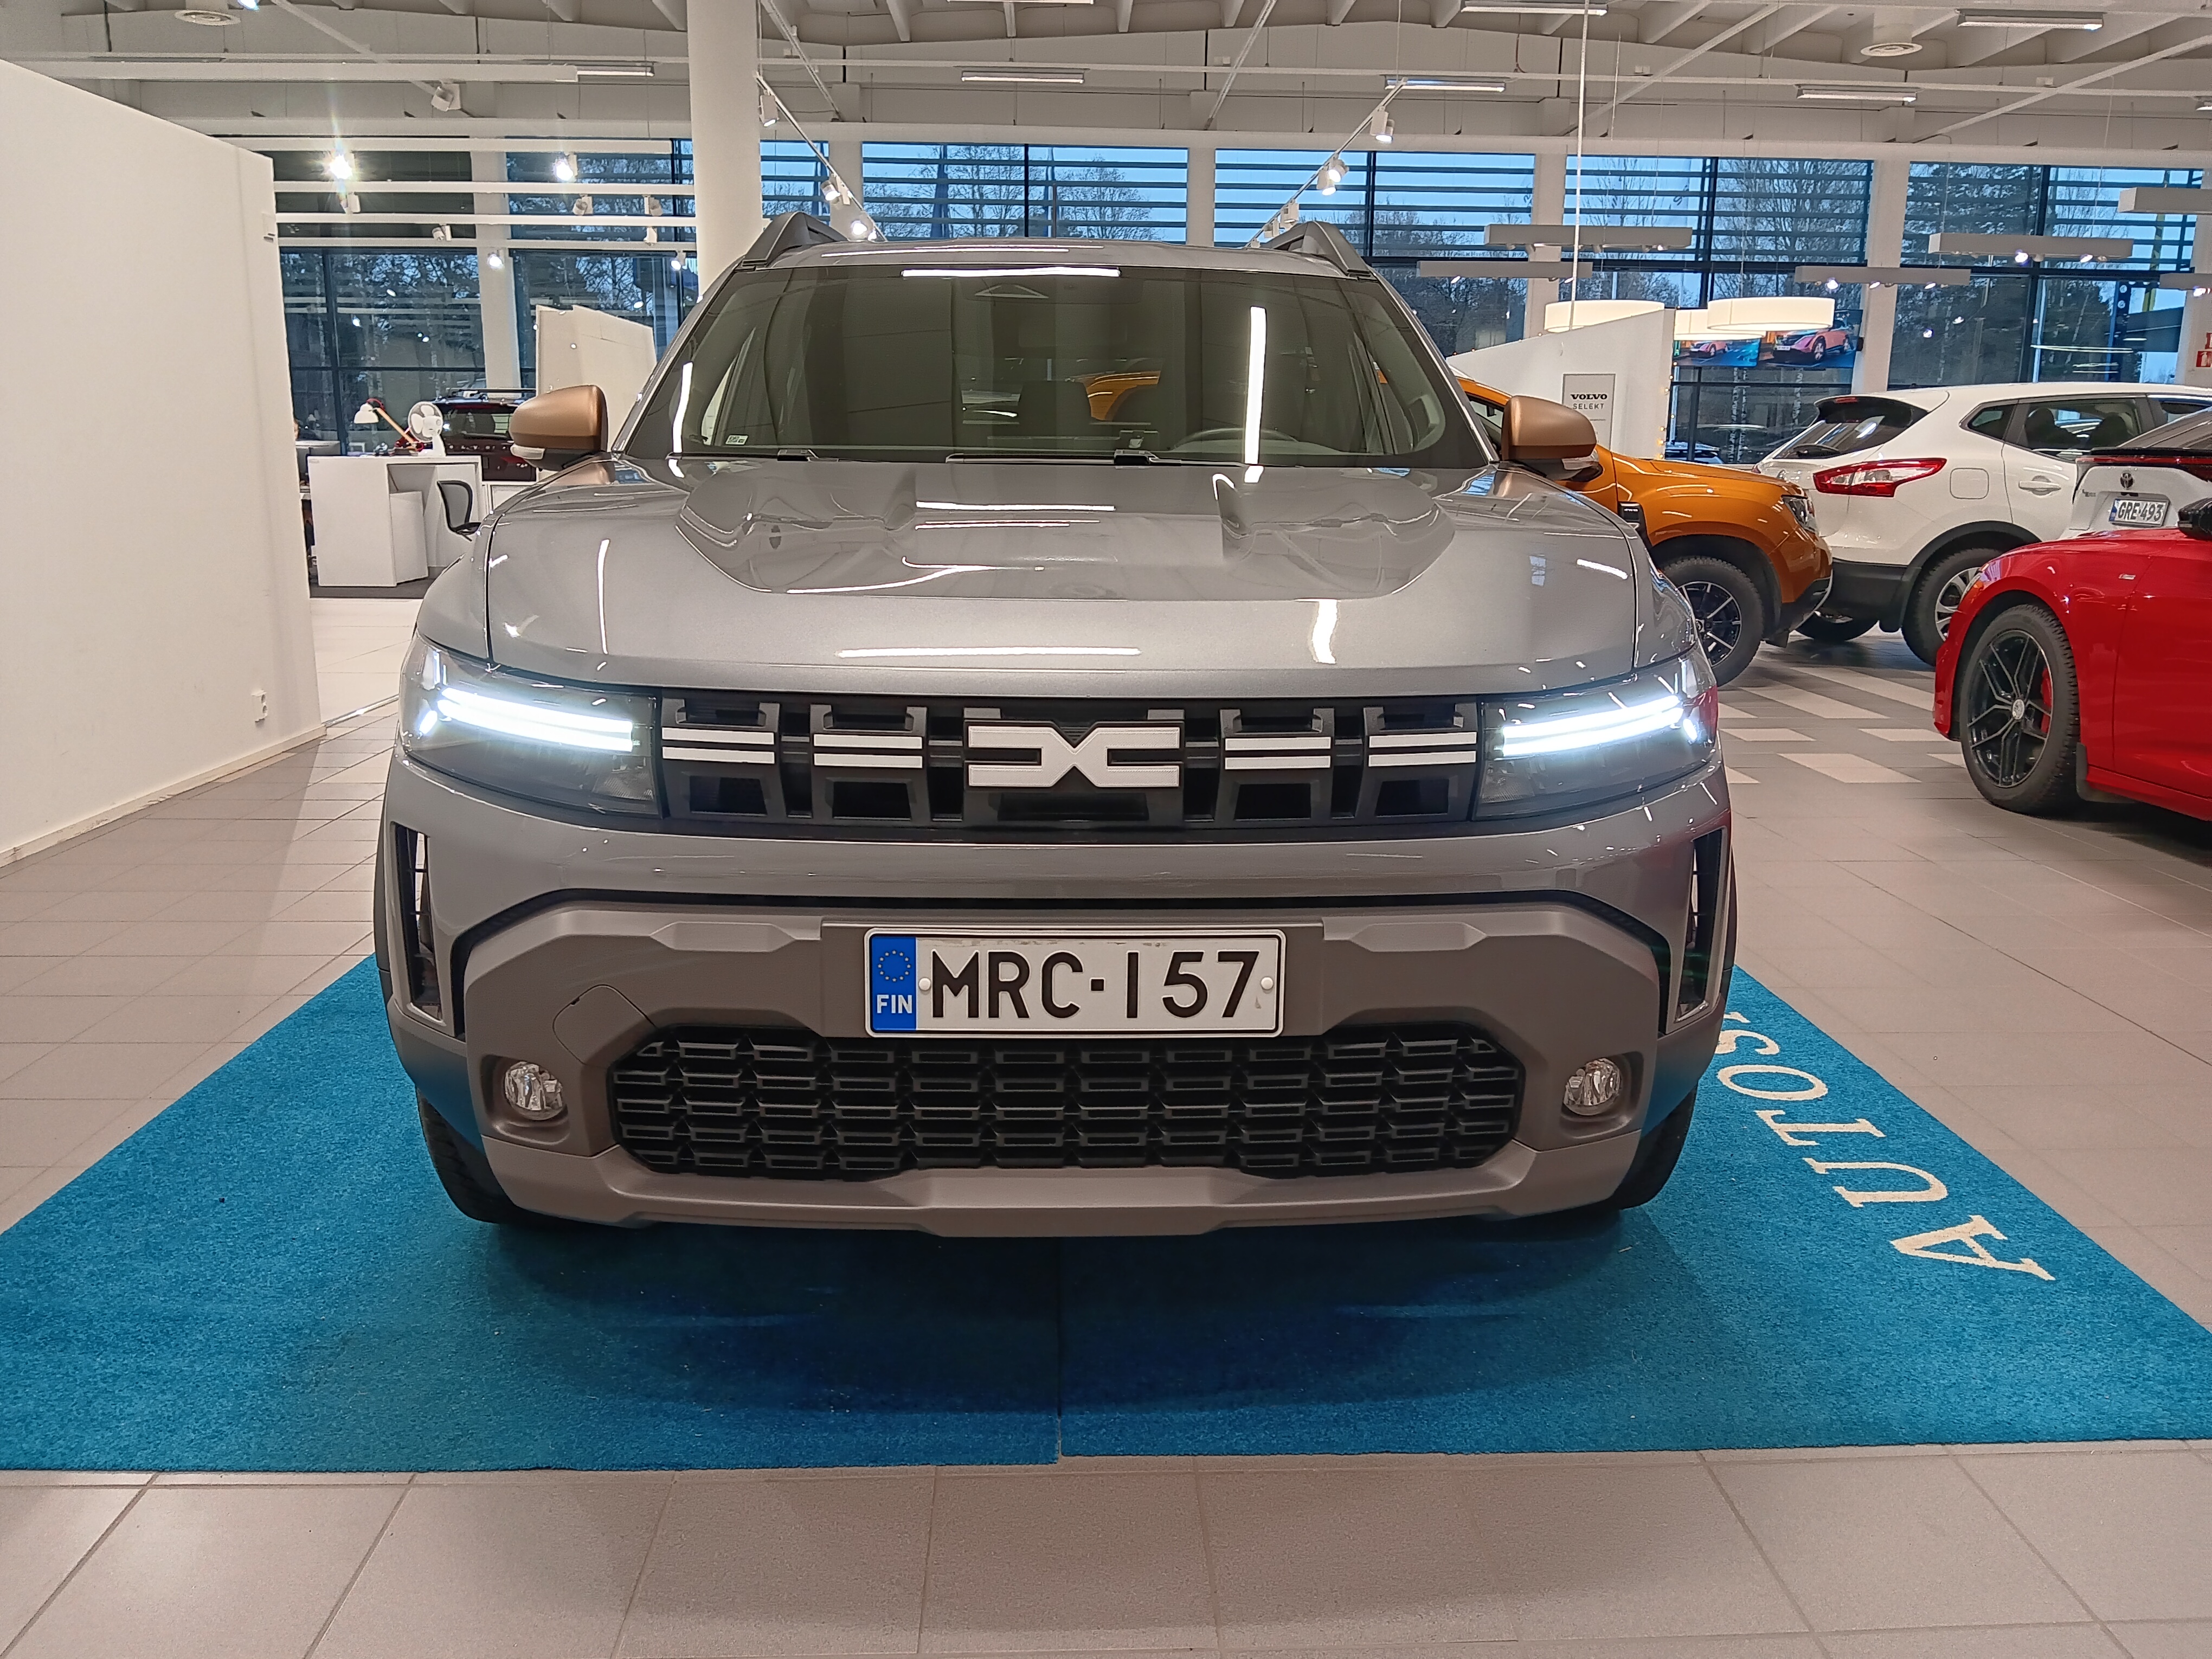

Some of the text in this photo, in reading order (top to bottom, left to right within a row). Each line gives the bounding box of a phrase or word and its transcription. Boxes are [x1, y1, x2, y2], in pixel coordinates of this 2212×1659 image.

[2118, 501, 2164, 522] GRE-493
[877, 950, 1261, 1019] FIN MRC-157
[1714, 1011, 2056, 1281] AUTOS
